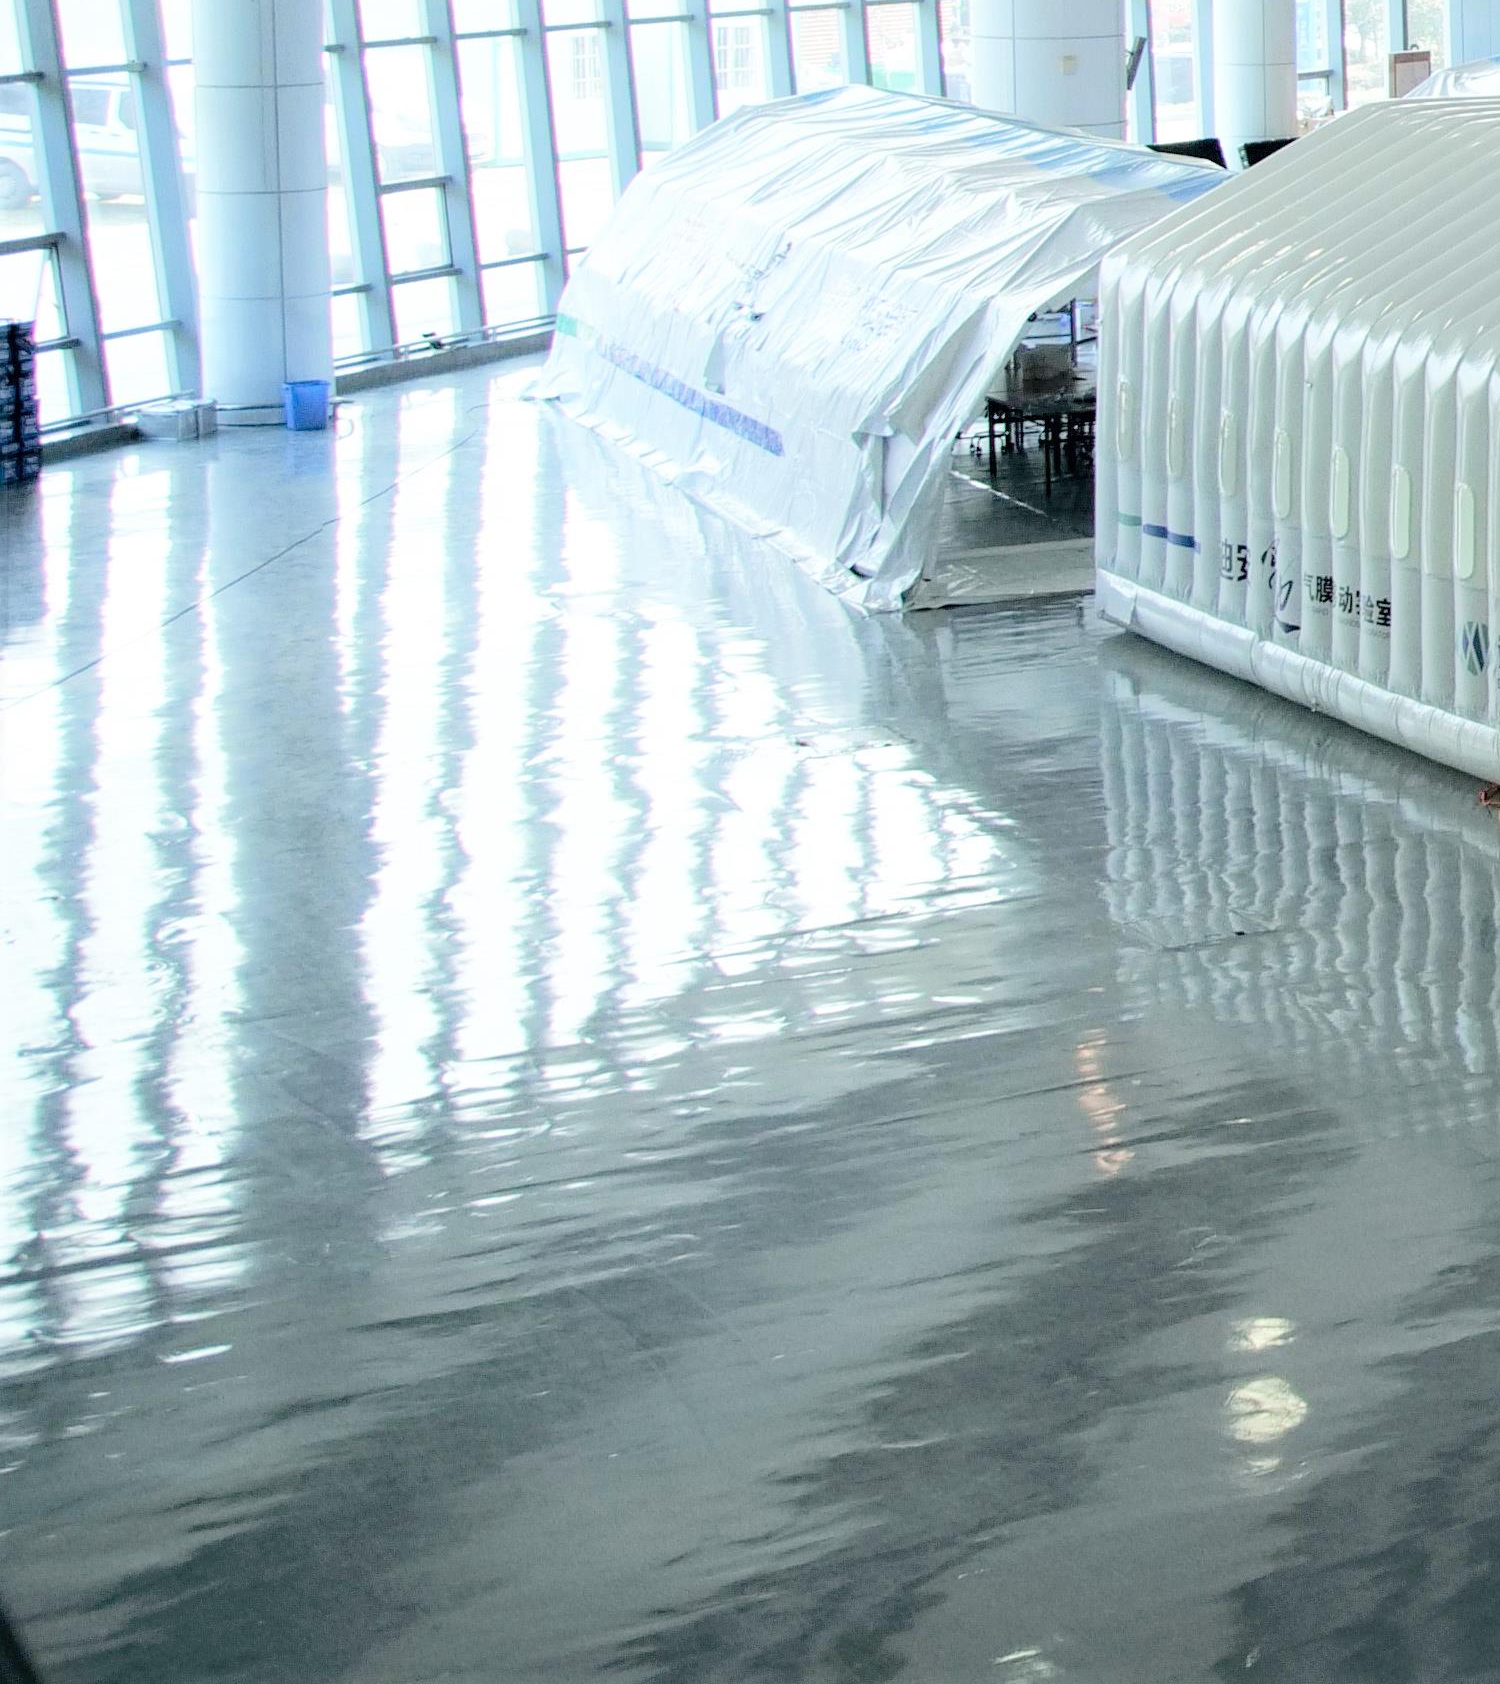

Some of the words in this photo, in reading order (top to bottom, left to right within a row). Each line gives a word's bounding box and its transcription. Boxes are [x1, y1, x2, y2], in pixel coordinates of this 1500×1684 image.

[1304, 572, 1391, 627] 气膜动验室
